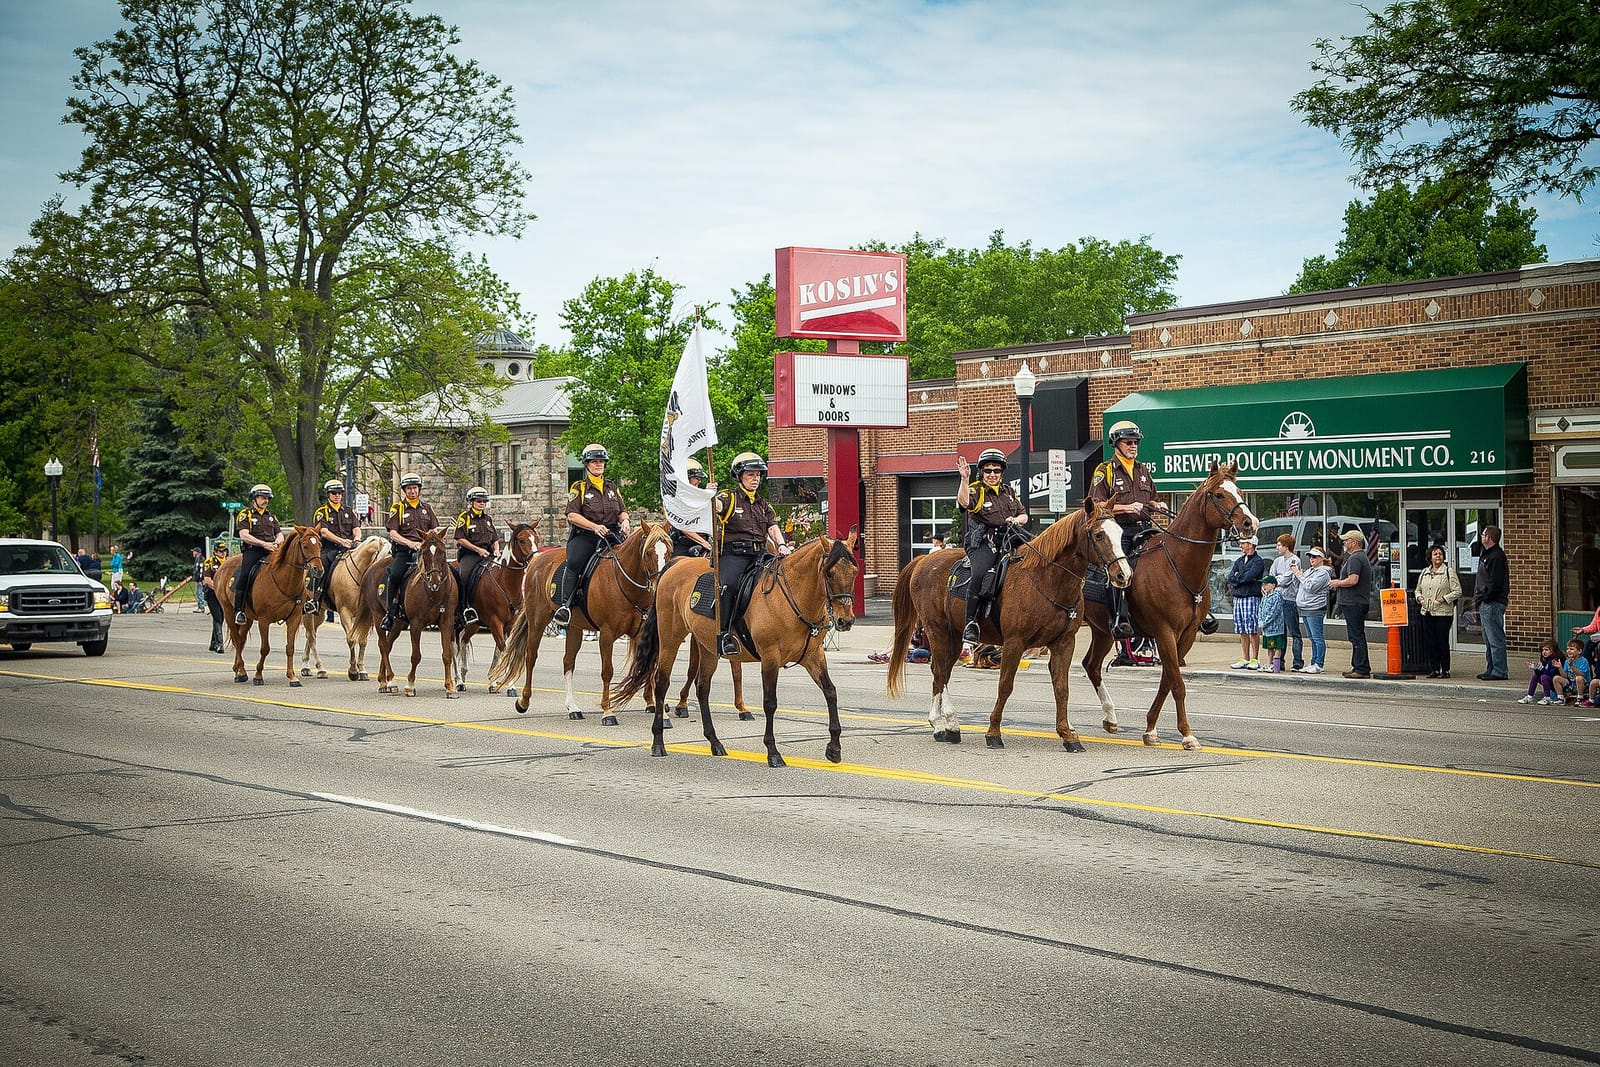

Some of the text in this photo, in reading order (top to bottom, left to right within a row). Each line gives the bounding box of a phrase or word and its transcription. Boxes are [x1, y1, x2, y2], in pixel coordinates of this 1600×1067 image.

[799, 269, 898, 306] KOSIN'S
[812, 383, 856, 396] WINDOWS
[829, 397, 836, 409] &
[818, 410, 850, 422] DOORS
[1307, 446, 1415, 470] MONUMENT
[1420, 445, 1455, 467] CO.
[1470, 450, 1496, 464] 216
[1142, 462, 1156, 473] 95
[1445, 490, 1458, 499] 216
